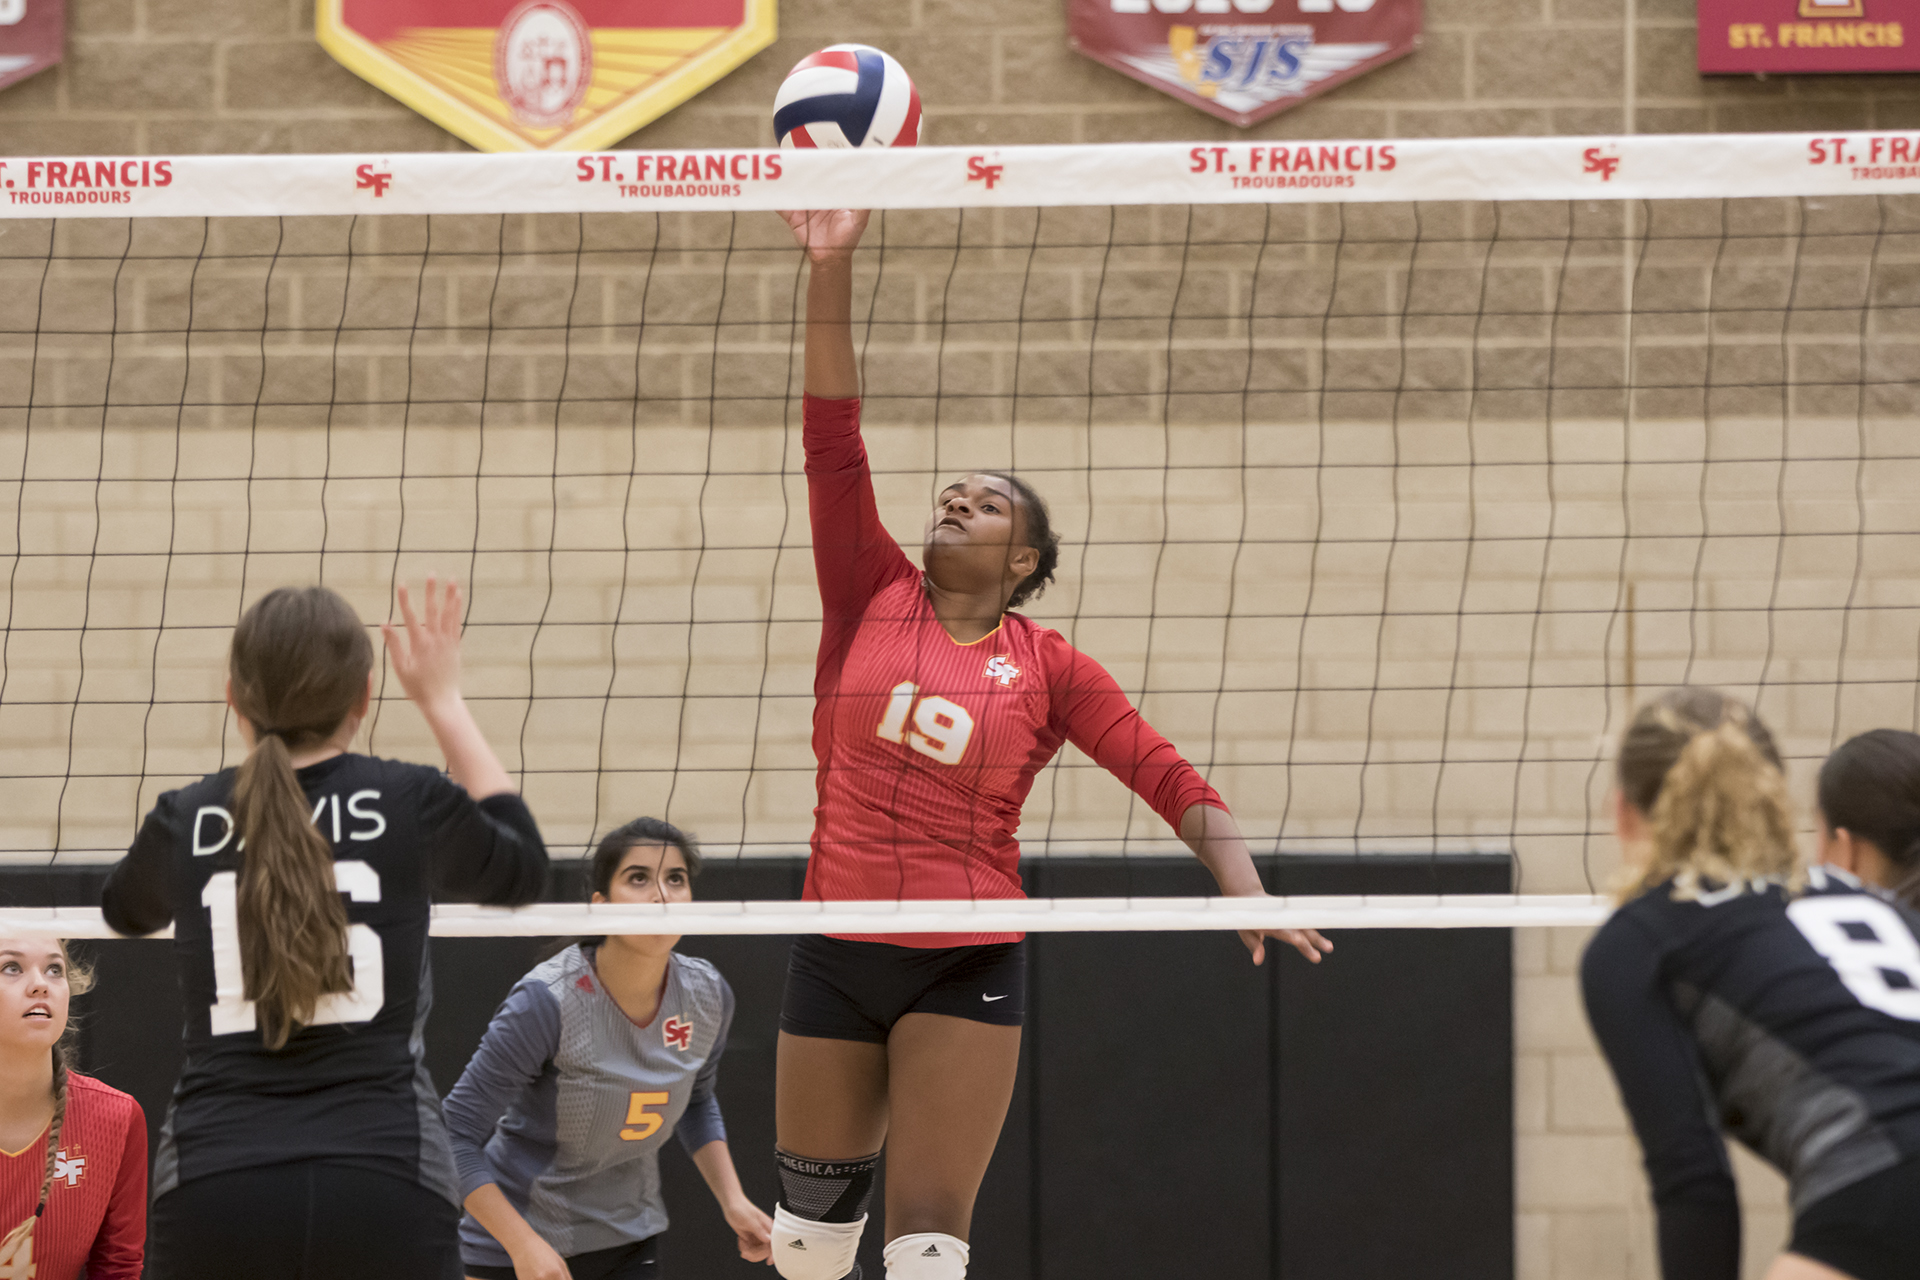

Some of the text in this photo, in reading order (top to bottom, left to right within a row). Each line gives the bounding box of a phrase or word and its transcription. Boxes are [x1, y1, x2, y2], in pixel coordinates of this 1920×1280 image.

[1728, 22, 1904, 48] ST. FRANCIS
[1189, 145, 1397, 173] ST. FRANCIS
[1584, 147, 1620, 181] SF
[1808, 136, 1920, 165] ST. FR
[27, 160, 173, 188] FRANCIS
[356, 163, 393, 198] SF
[576, 154, 783, 182] ST. FRANCIS
[967, 155, 1004, 190] SF
[1230, 175, 1356, 189] TROUBADOURS
[9, 190, 131, 205] TROUBADOURS
[618, 184, 742, 198] TROUBADOURS
[982, 654, 1022, 688] SF
[875, 679, 975, 766] 19
[192, 789, 387, 856] DIS
[662, 1015, 694, 1051] SF
[619, 1090, 670, 1141] 5
